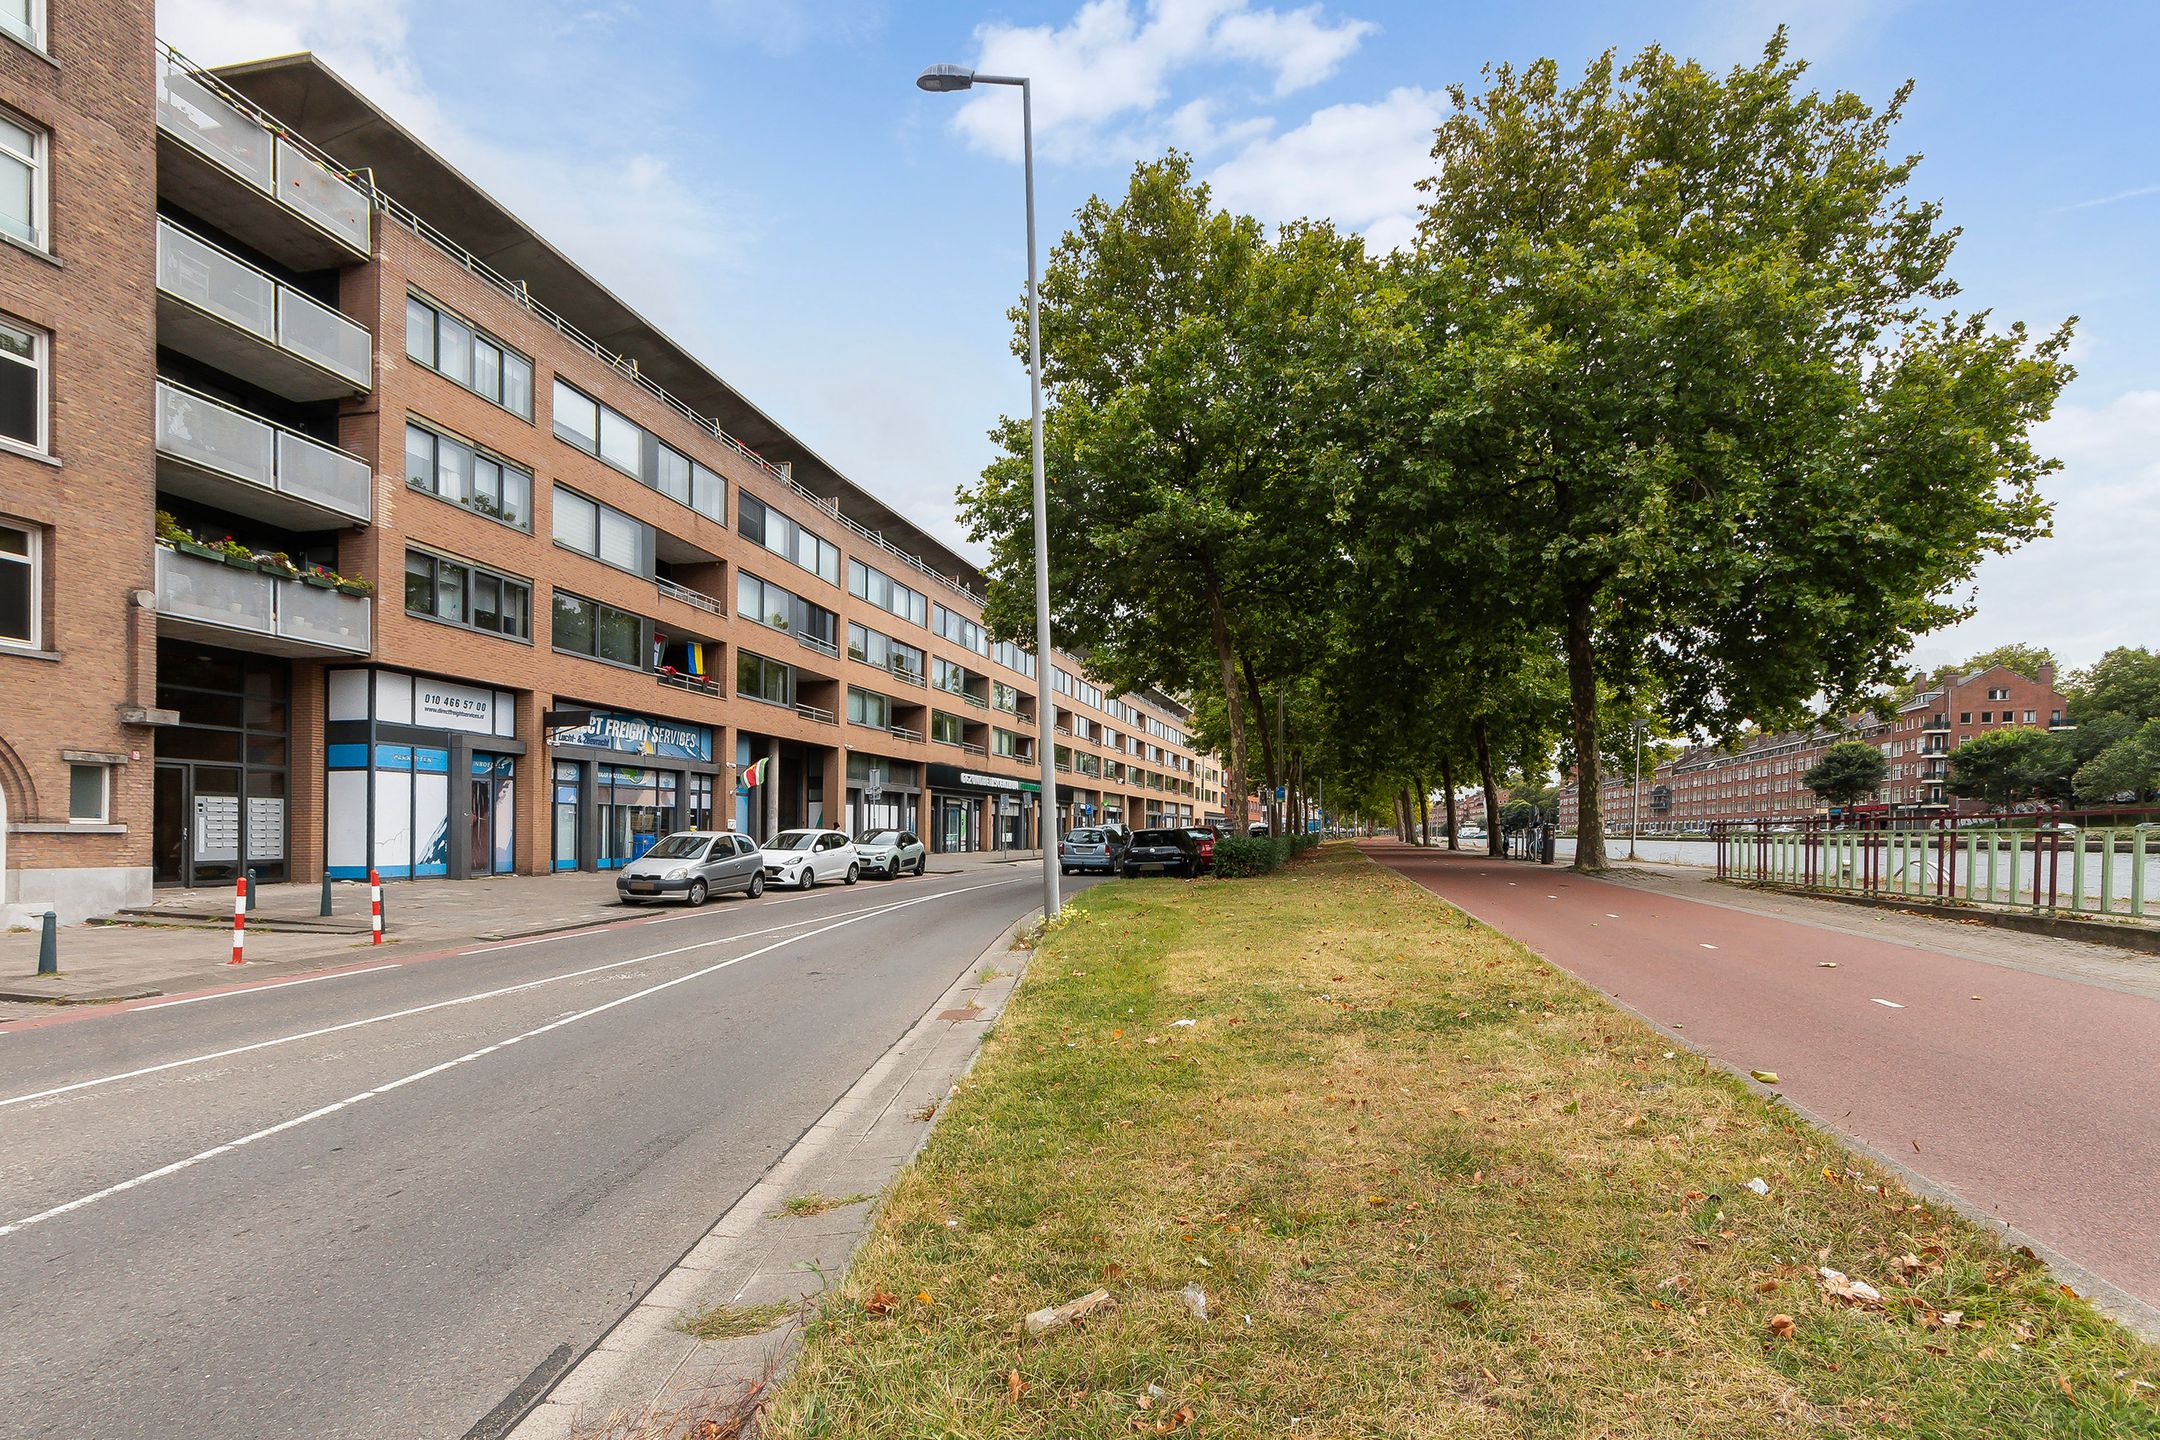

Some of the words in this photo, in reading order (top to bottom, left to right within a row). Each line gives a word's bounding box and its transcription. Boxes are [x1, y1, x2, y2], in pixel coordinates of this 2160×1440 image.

[424, 694, 440, 705] 010
[443, 697, 460, 708] 466
[463, 700, 474, 710] 57
[476, 702, 487, 712] 00
[577, 735, 582, 743] &
[605, 718, 650, 742] FREIGHT
[651, 726, 697, 748] SERVICES
